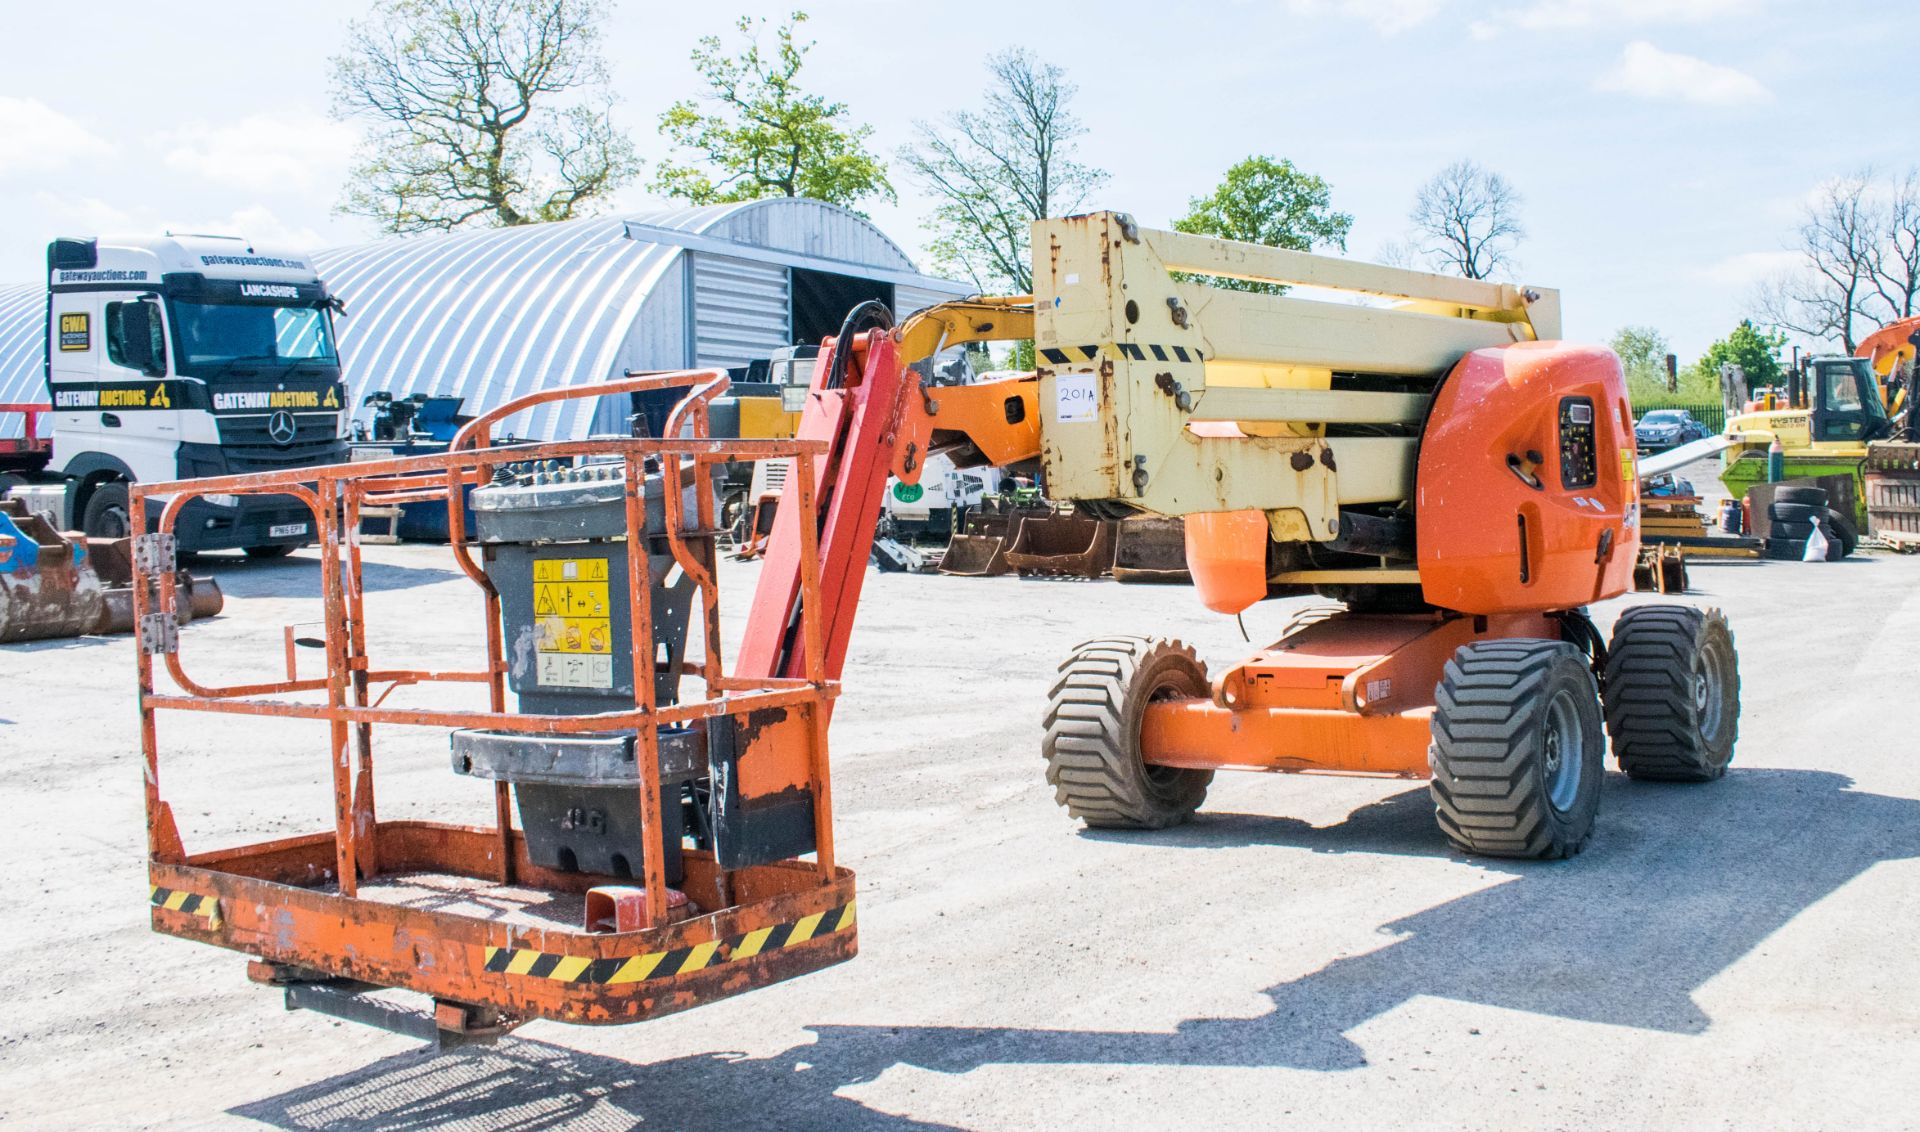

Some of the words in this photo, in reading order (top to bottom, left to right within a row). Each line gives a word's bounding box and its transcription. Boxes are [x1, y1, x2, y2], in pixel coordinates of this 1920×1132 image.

[201, 255, 306, 269] gatewayauctions.com
[60, 269, 148, 282] gatewayauctions.com
[62, 315, 87, 333] GWA
[55, 391, 99, 406] GATEWAY
[100, 390, 146, 405] AUCTIONS
[213, 392, 270, 409] GATEWAY
[270, 391, 318, 407] AUCTIONS
[1060, 388, 1094, 402] 201A
